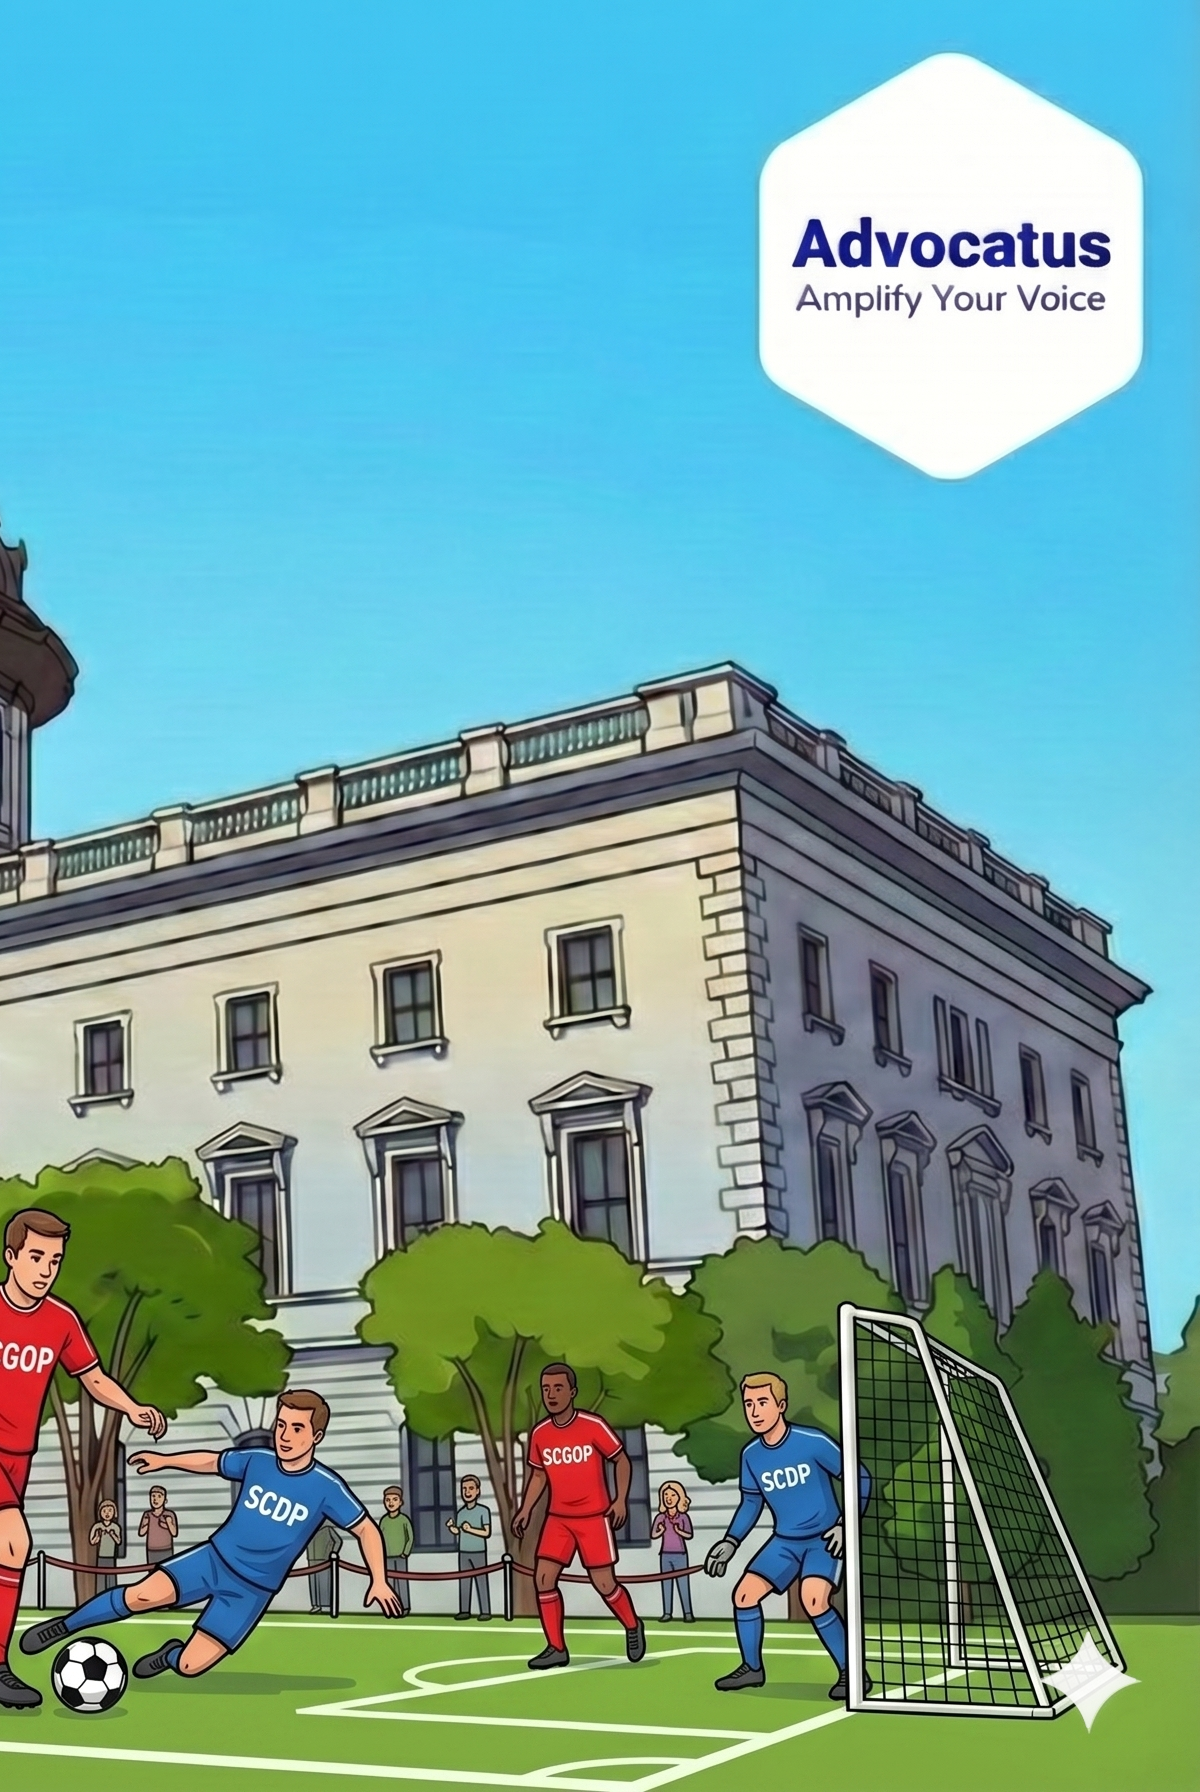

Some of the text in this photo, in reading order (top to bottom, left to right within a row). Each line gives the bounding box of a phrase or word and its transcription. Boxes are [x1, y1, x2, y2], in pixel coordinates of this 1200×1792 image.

[542, 1445, 593, 1466] SCGOP
[761, 1463, 811, 1492] SCDP
[244, 1484, 309, 1527] SCDP
